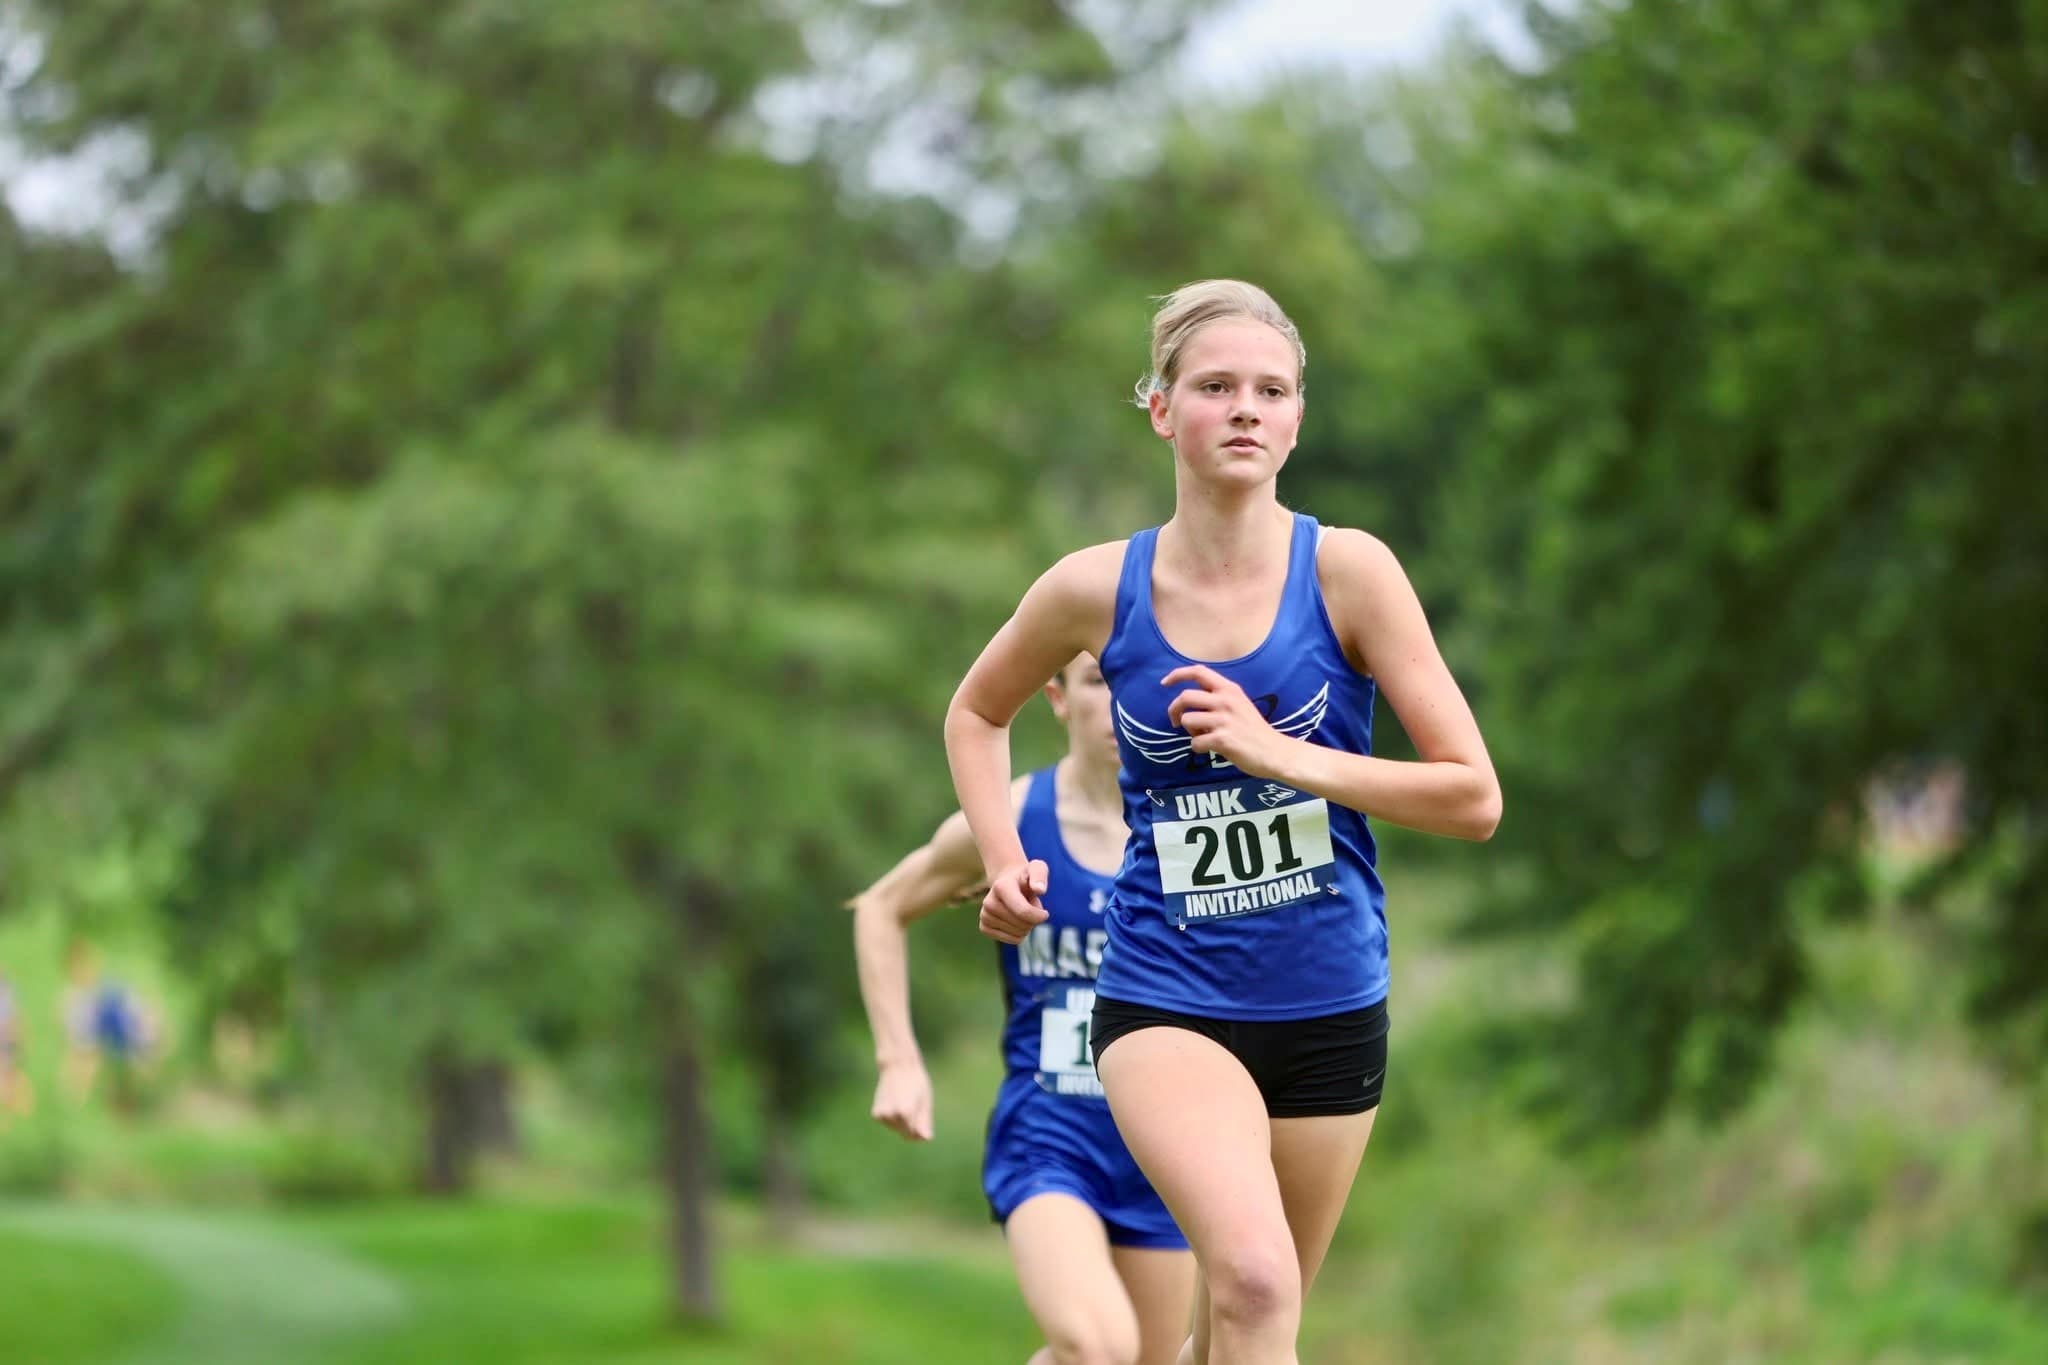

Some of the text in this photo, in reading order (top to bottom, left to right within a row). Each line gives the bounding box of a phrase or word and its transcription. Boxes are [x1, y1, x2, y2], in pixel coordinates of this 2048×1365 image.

[1175, 788, 1247, 820] UNK
[1185, 813, 1303, 887] 201
[1185, 872, 1321, 918] INVITATIONAL
